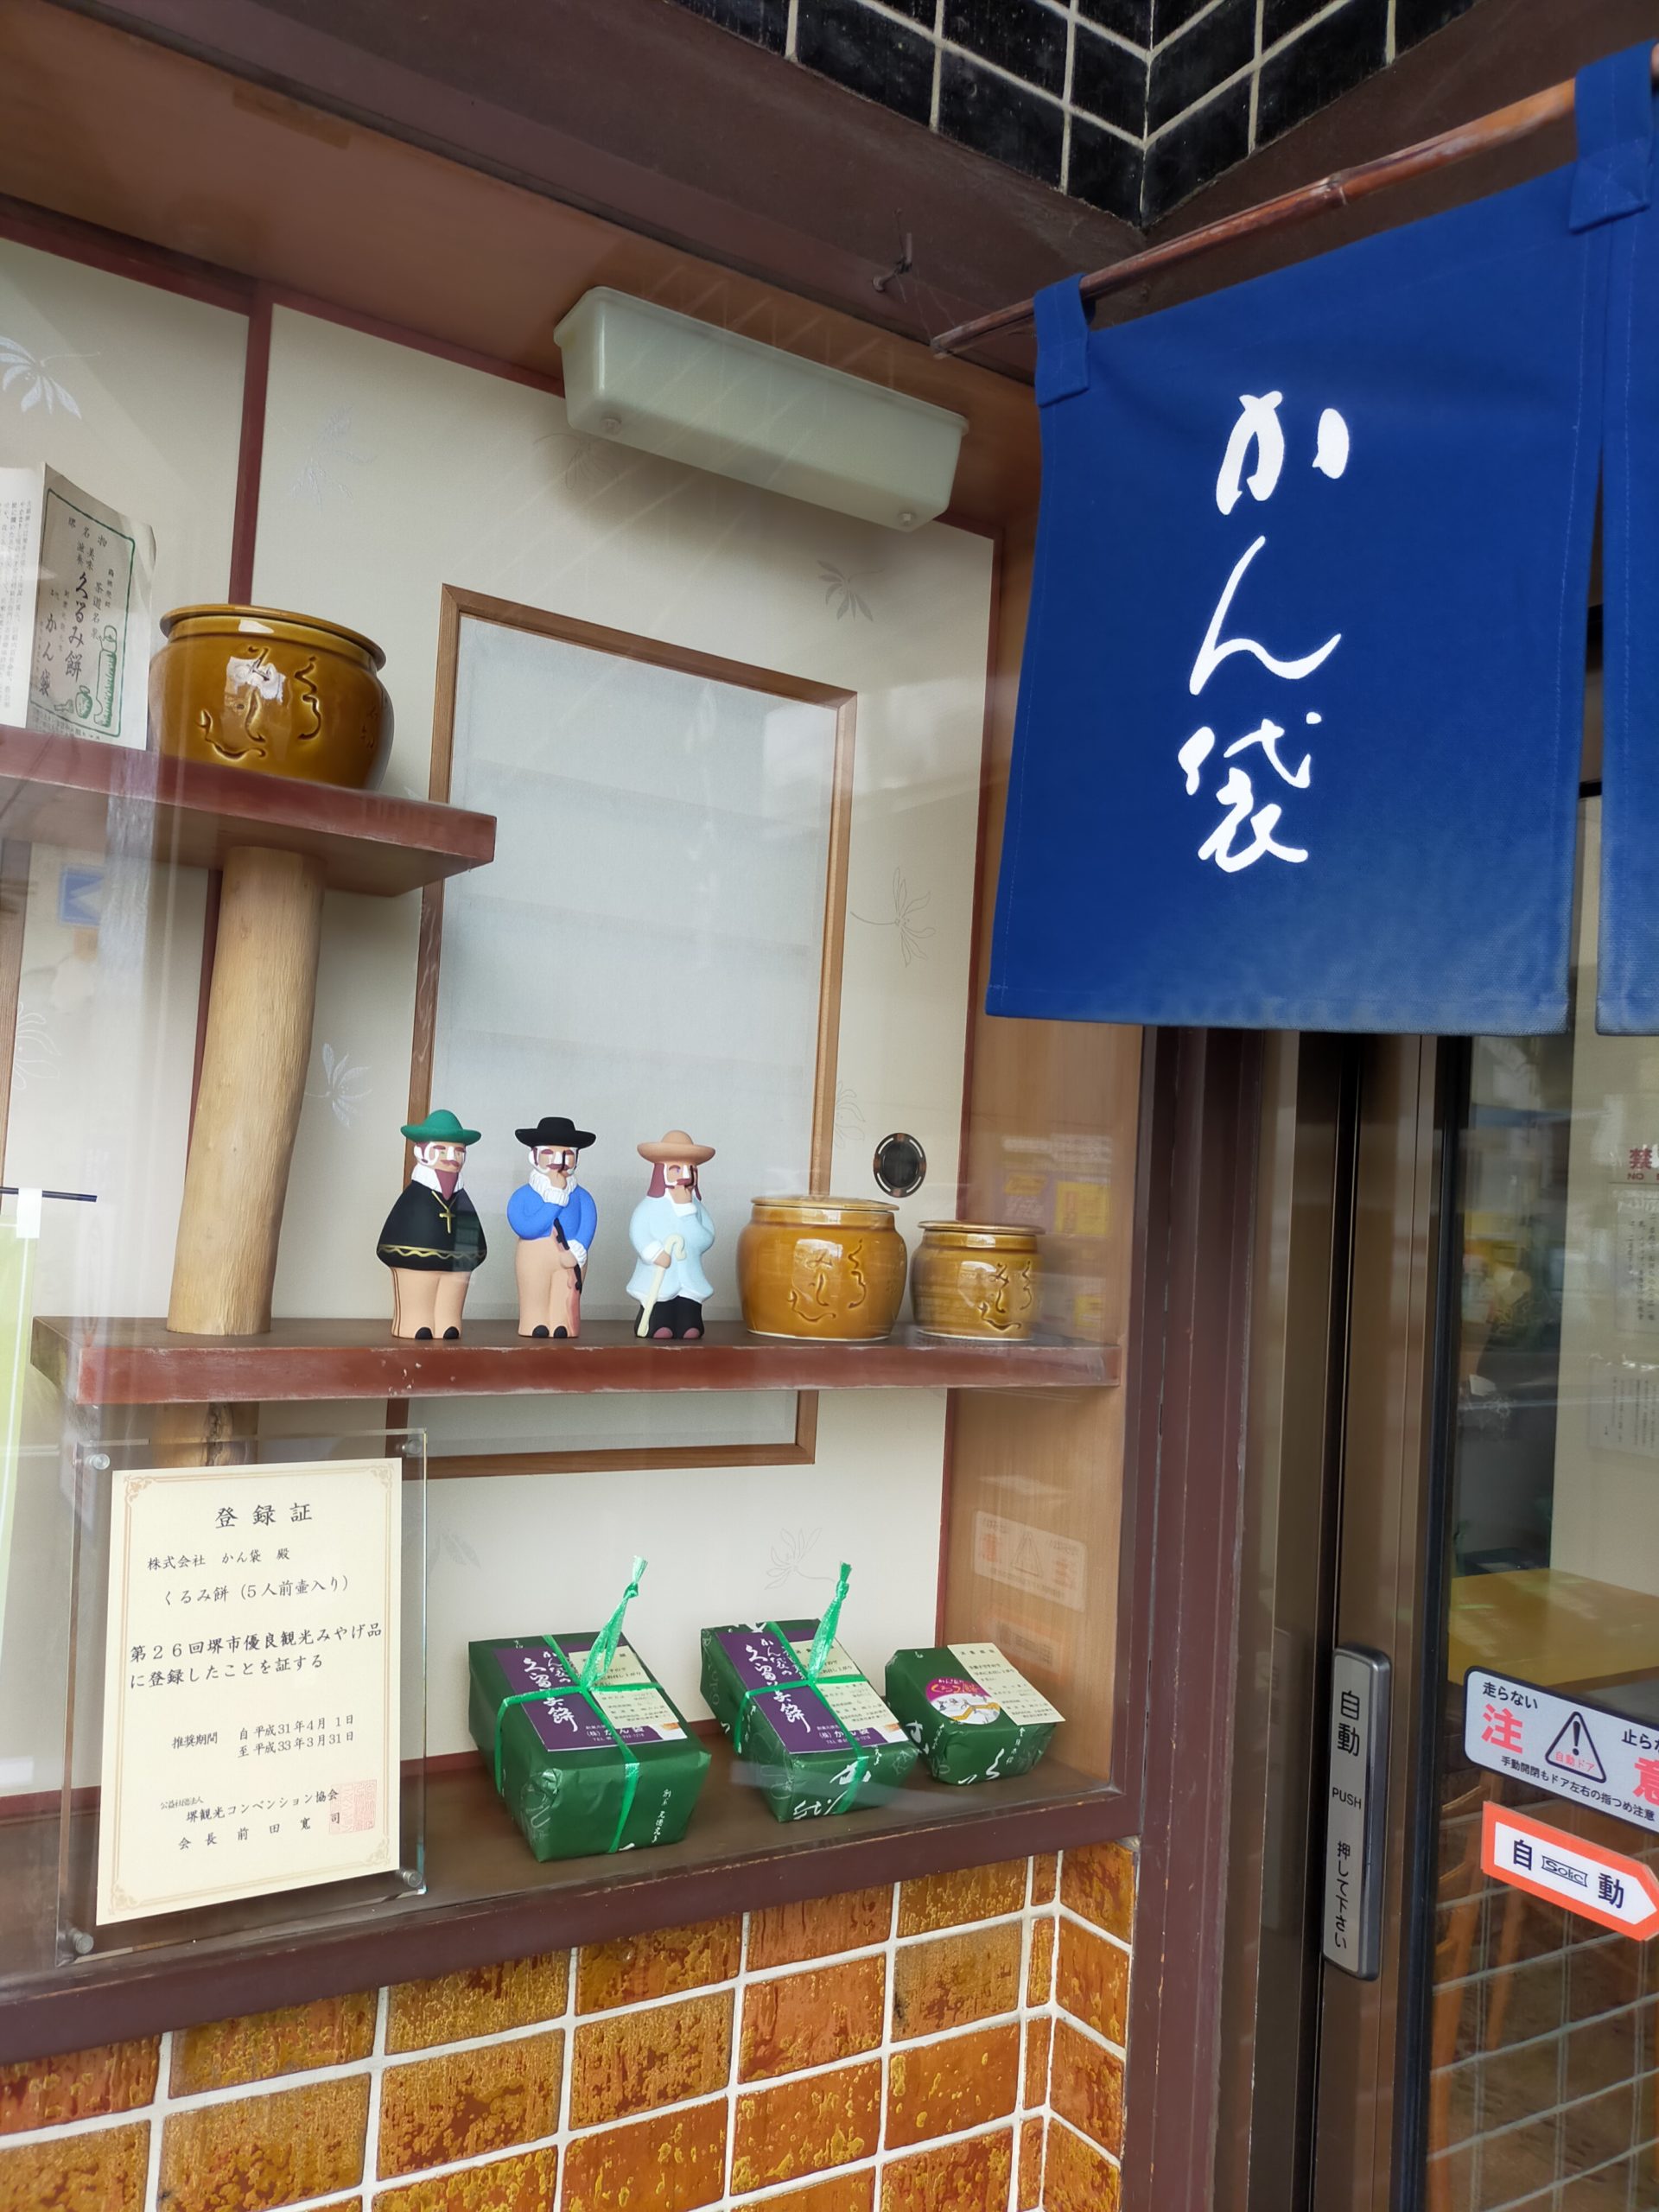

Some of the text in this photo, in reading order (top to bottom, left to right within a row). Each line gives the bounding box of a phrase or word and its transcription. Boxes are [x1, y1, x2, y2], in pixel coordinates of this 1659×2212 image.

[1179, 391, 1350, 873] かん袋
[214, 1503, 313, 1529] 登録証
[147, 1548, 290, 1570] 株式会社 かん袋 殿
[163, 1586, 228, 1605] くるみ餅
[130, 1655, 323, 1688] に登録したことを証する
[1483, 1681, 1537, 1709] 走らない
[1338, 1690, 1360, 1757] 自動
[1481, 1704, 1522, 1754] 注
[1555, 1751, 1594, 1771] 自動ドア
[187, 1788, 339, 1823] 堺観光コンベンション協会
[1332, 1788, 1362, 1809] PUSH
[1501, 1756, 1655, 1821] 手動開閉もドア左右の指つめ注意
[1512, 1840, 1533, 1871] 自
[1599, 1873, 1624, 1909] 動
[1335, 1842, 1351, 1949] 押して下さい
